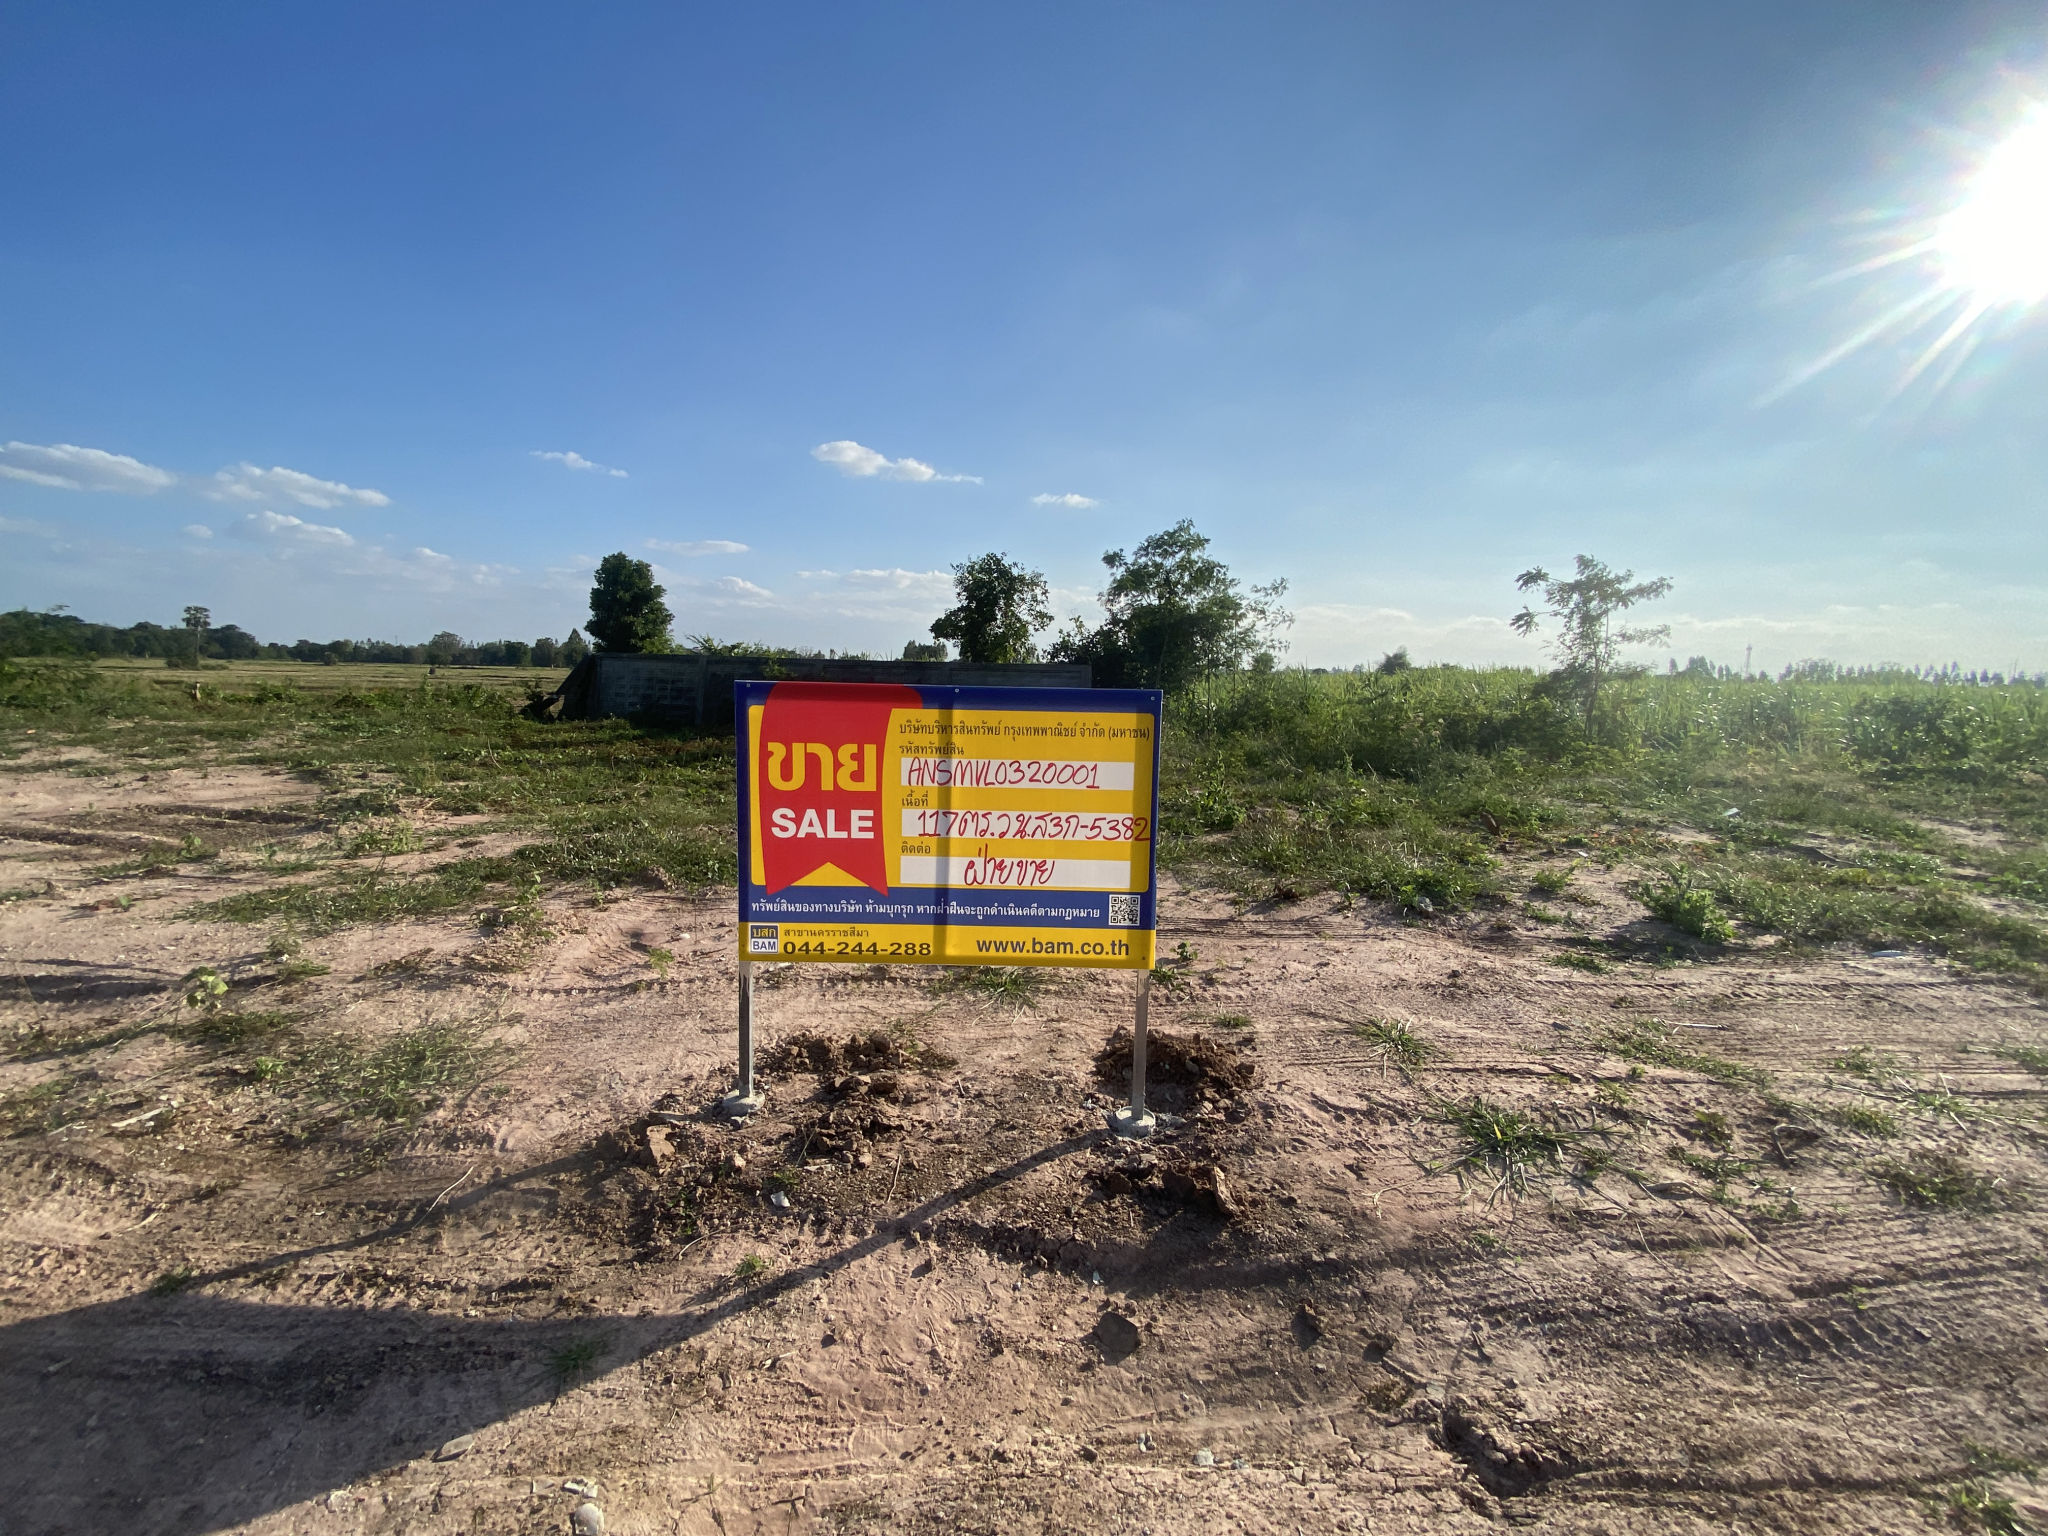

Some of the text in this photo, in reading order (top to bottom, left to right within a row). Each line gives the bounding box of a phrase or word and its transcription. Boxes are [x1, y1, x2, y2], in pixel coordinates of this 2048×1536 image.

[899, 719, 1151, 742] บริษัทบริหารสินทรัพย์ กรุงเทพพาณิชย์ จำกัด (มหาชน)
[899, 741, 964, 756] รหัสทรัพย์สิน
[767, 741, 877, 792] ขาย
[901, 789, 930, 807] เนื้อที่
[771, 807, 875, 839] SALE
[901, 841, 931, 855] ติดต่อ
[963, 843, 1056, 887] ฝ่ายขาย
[752, 897, 863, 914] ทรัพย์สินของทางบริษัท
[865, 902, 914, 918] ห้ามบุกรุก
[752, 927, 776, 938] บสก
[784, 927, 869, 938] สาขานครราชสีมา
[752, 940, 777, 951] BAM
[783, 941, 932, 956] 044-244-288
[976, 937, 1130, 957] www.bam.co.th
